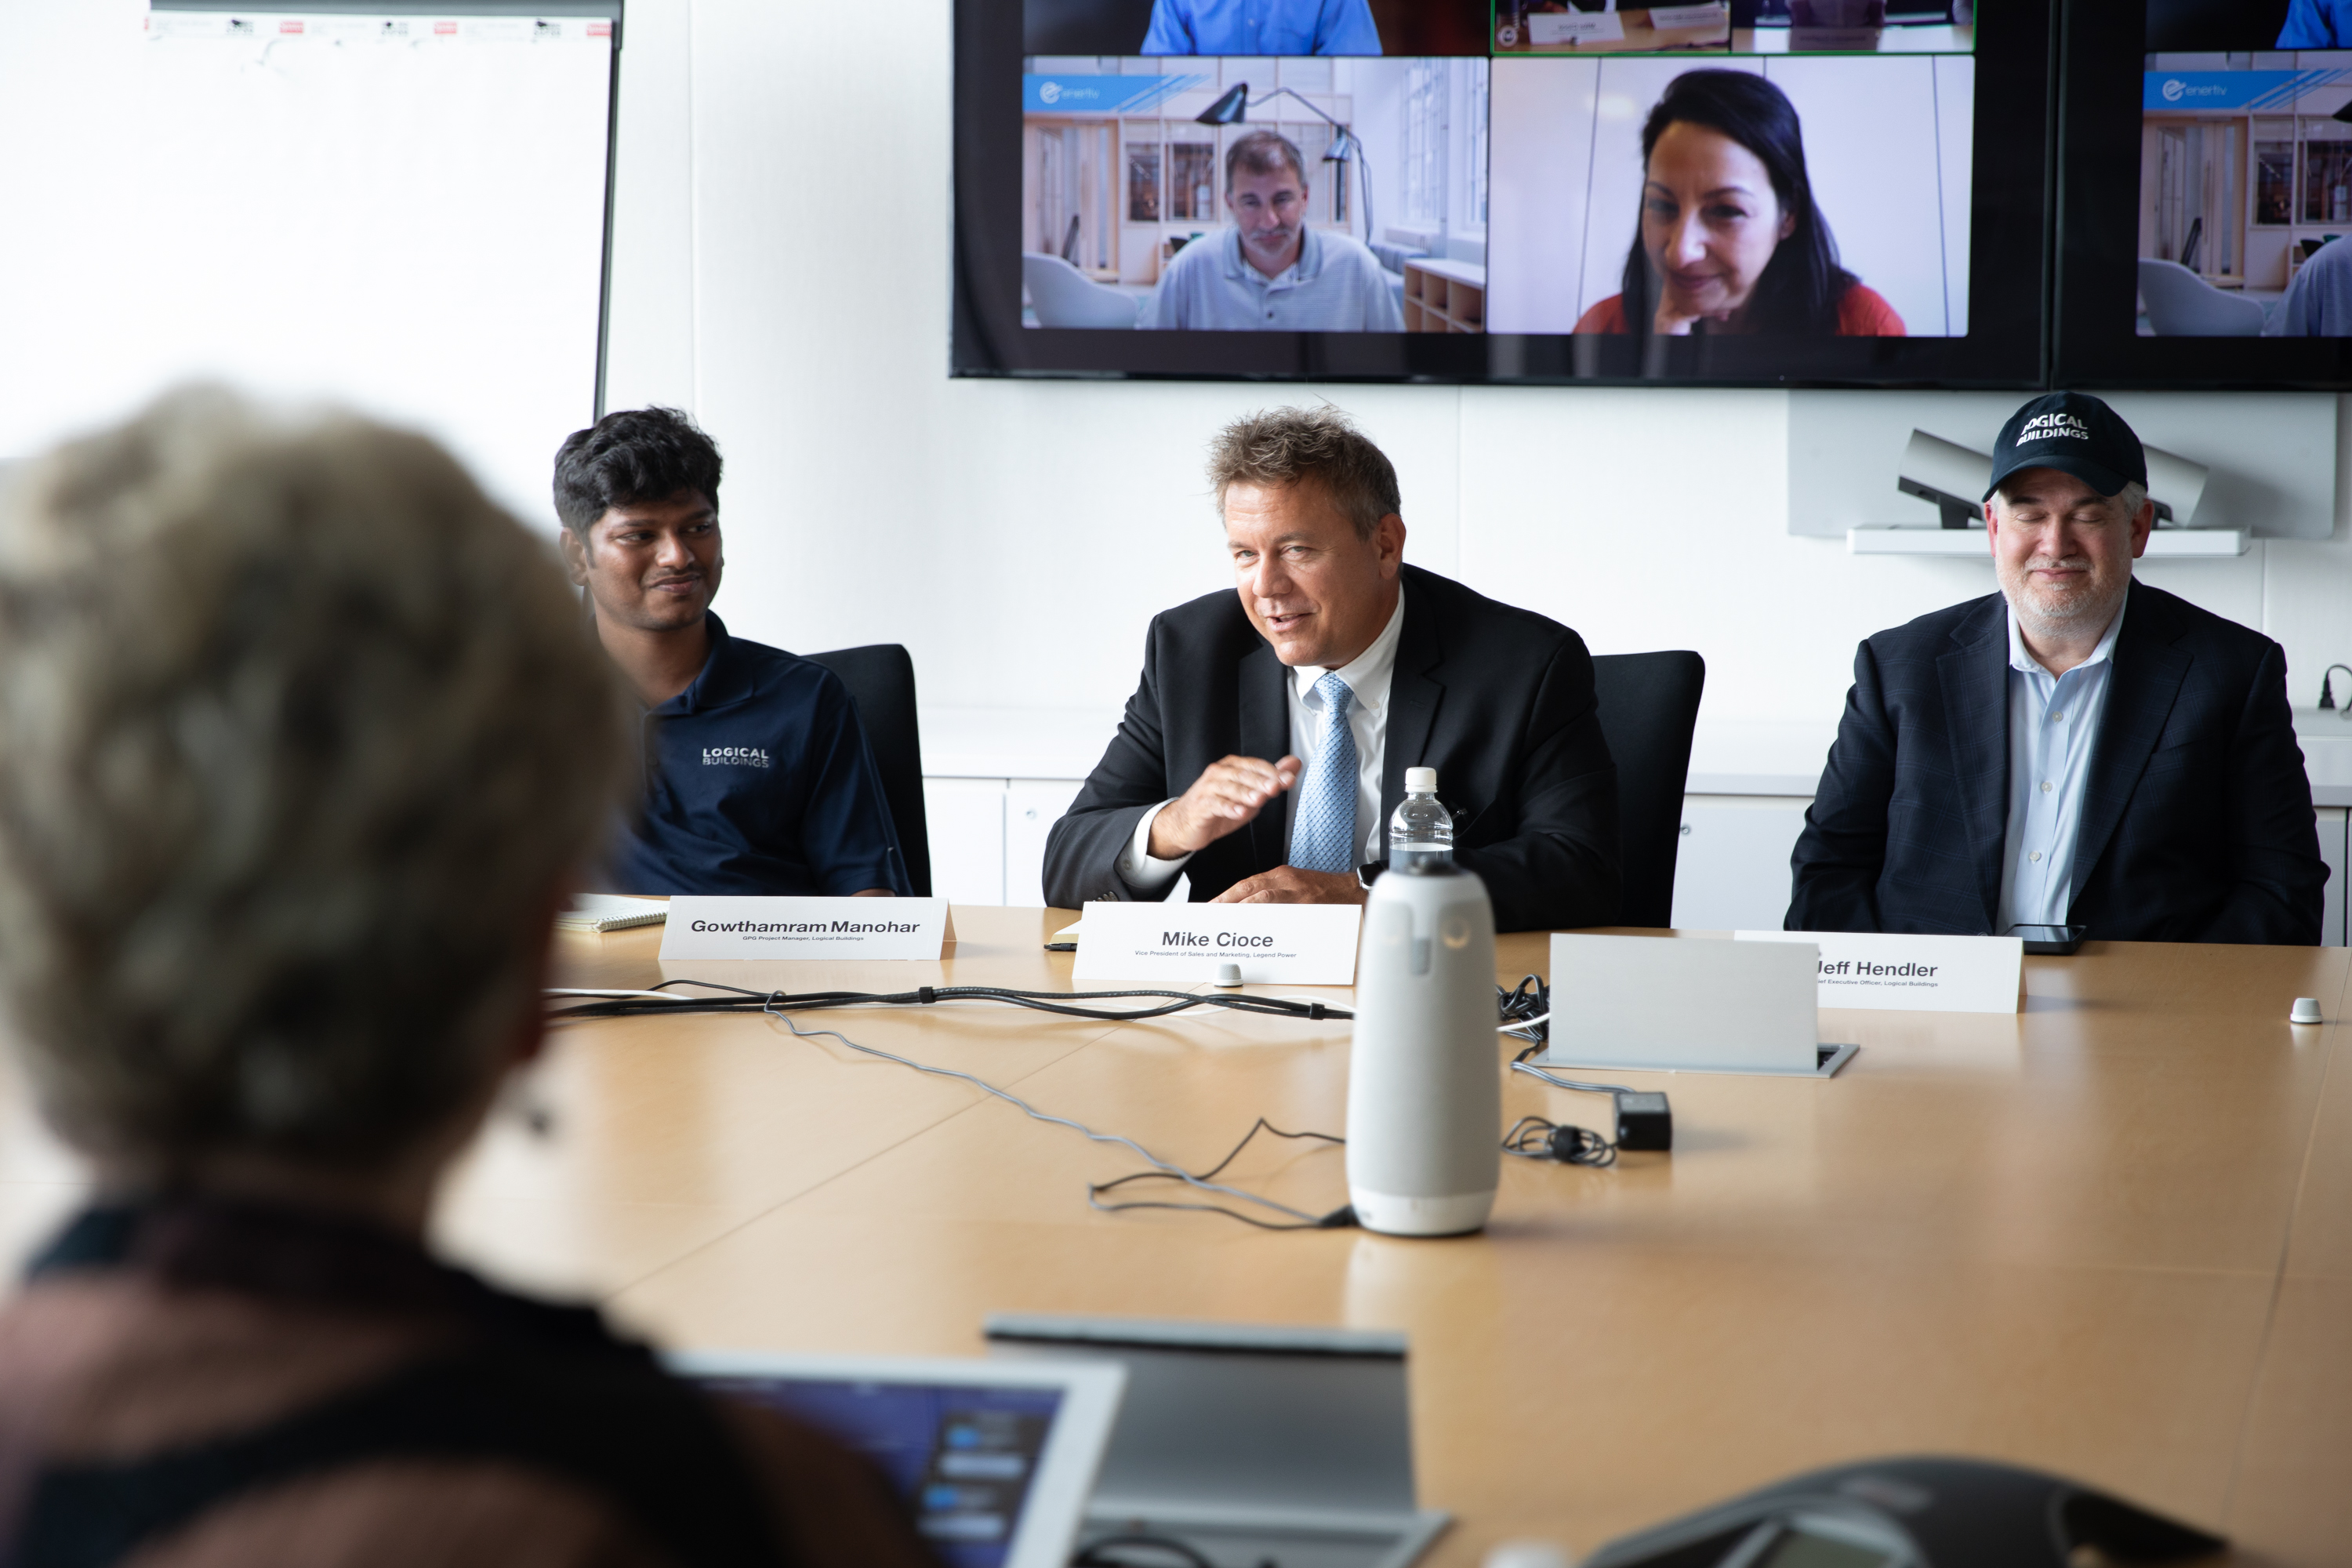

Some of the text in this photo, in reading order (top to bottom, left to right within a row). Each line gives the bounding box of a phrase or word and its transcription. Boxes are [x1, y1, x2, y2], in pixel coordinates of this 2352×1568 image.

[2185, 84, 2228, 96] enertiv
[2020, 413, 2089, 436] LOGICAL
[2016, 427, 2089, 448] BUILDINGS
[702, 747, 769, 759] LOGICAL
[702, 757, 769, 768] BUILDINGS
[691, 920, 920, 933] Gowthamram Manohar
[1162, 931, 1274, 948] Mike Cioce
[1856, 961, 1939, 978] Hendler
